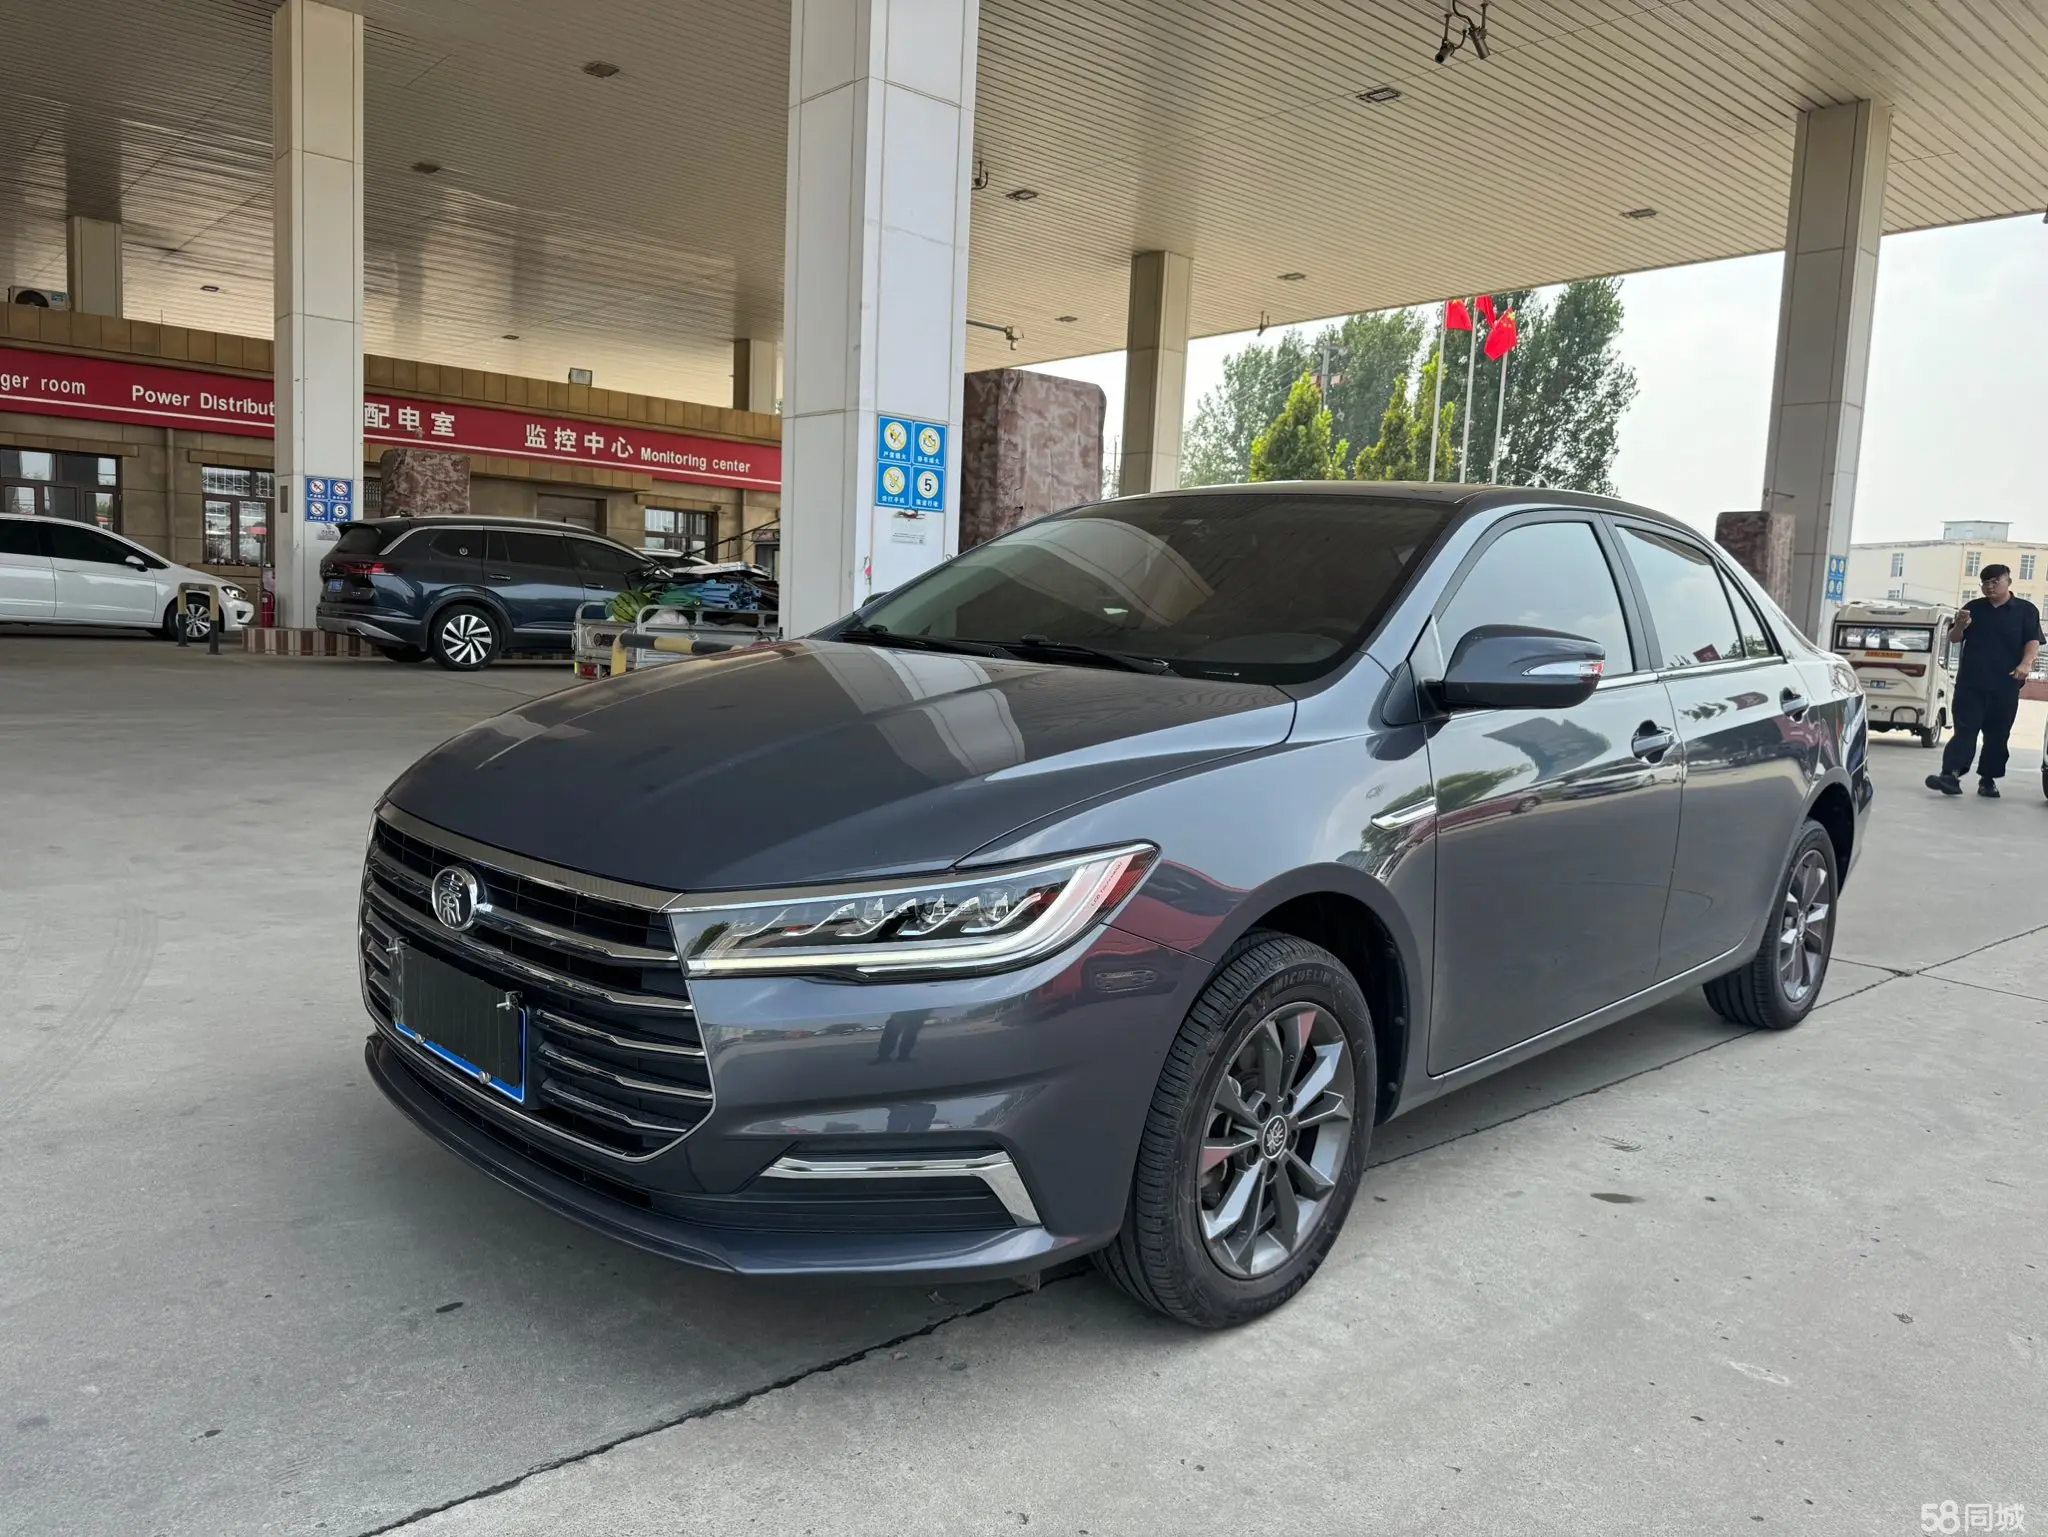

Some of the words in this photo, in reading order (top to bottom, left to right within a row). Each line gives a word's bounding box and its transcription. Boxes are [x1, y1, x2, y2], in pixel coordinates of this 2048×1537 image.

[0, 373, 29, 391] ger
[41, 378, 86, 395] room
[132, 385, 190, 407] Power
[200, 392, 275, 416] Distribut
[364, 402, 455, 437] 配电室
[525, 423, 634, 458] 监控中心
[640, 447, 707, 471] Monitoring
[712, 458, 751, 473] center
[924, 478, 932, 492] 5
[337, 507, 344, 515] 5
